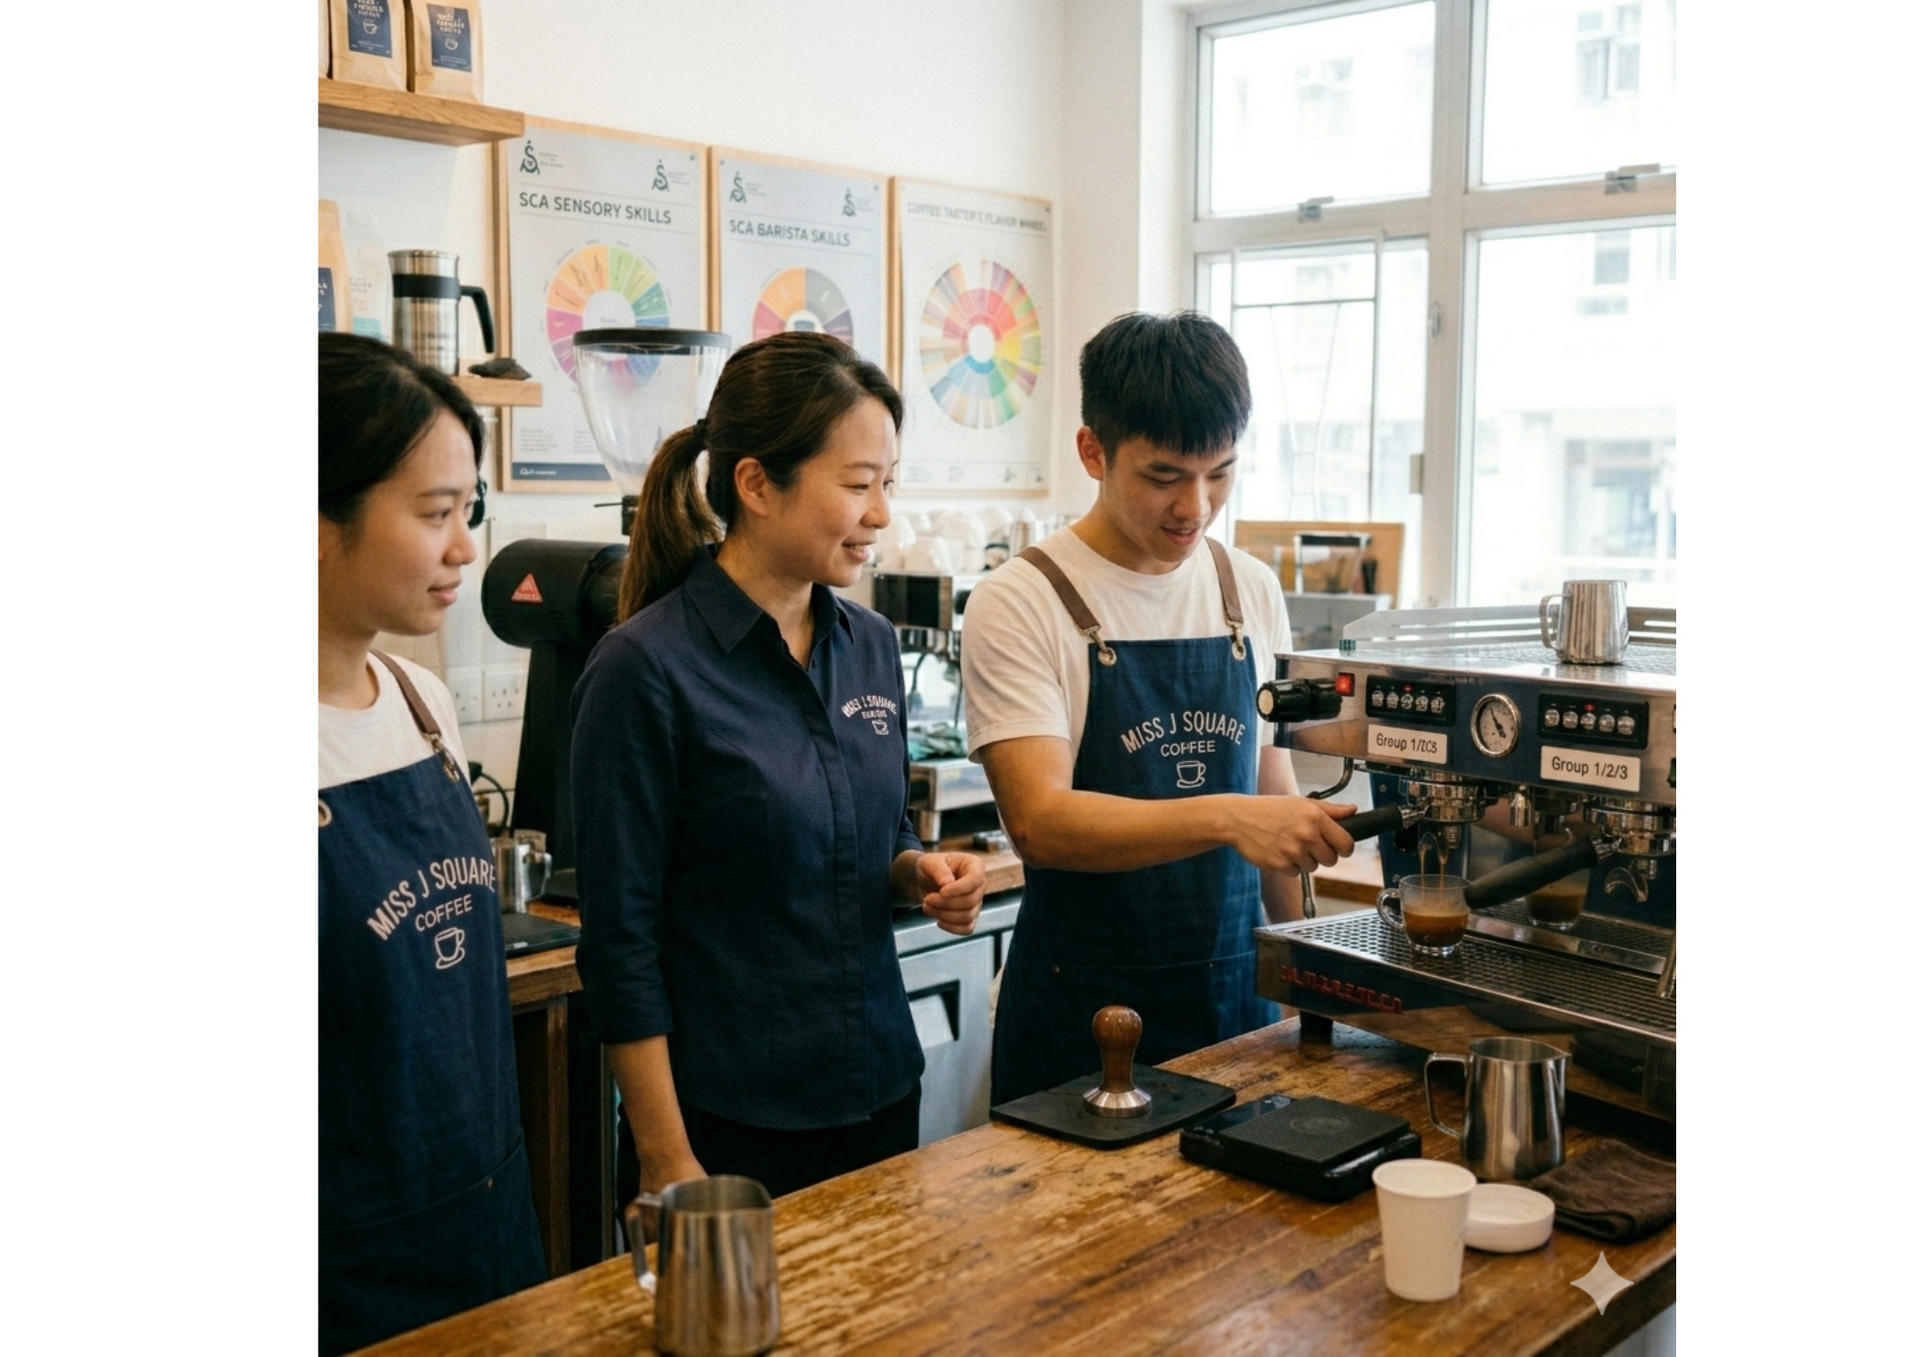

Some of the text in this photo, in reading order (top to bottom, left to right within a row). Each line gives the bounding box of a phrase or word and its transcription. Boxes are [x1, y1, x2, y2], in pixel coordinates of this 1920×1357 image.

[519, 192, 671, 225] SCA SENSORY SKILLS
[729, 219, 850, 246] SCA BARISTA SKILLS
[1121, 711, 1246, 753] MISS J SQUARE
[1376, 733, 1407, 751] Group
[1160, 740, 1216, 757] COFFEE
[1552, 756, 1628, 780] Group 1/2/3
[367, 856, 496, 940] MISS J SQUARE
[415, 893, 473, 932] COFFEE
